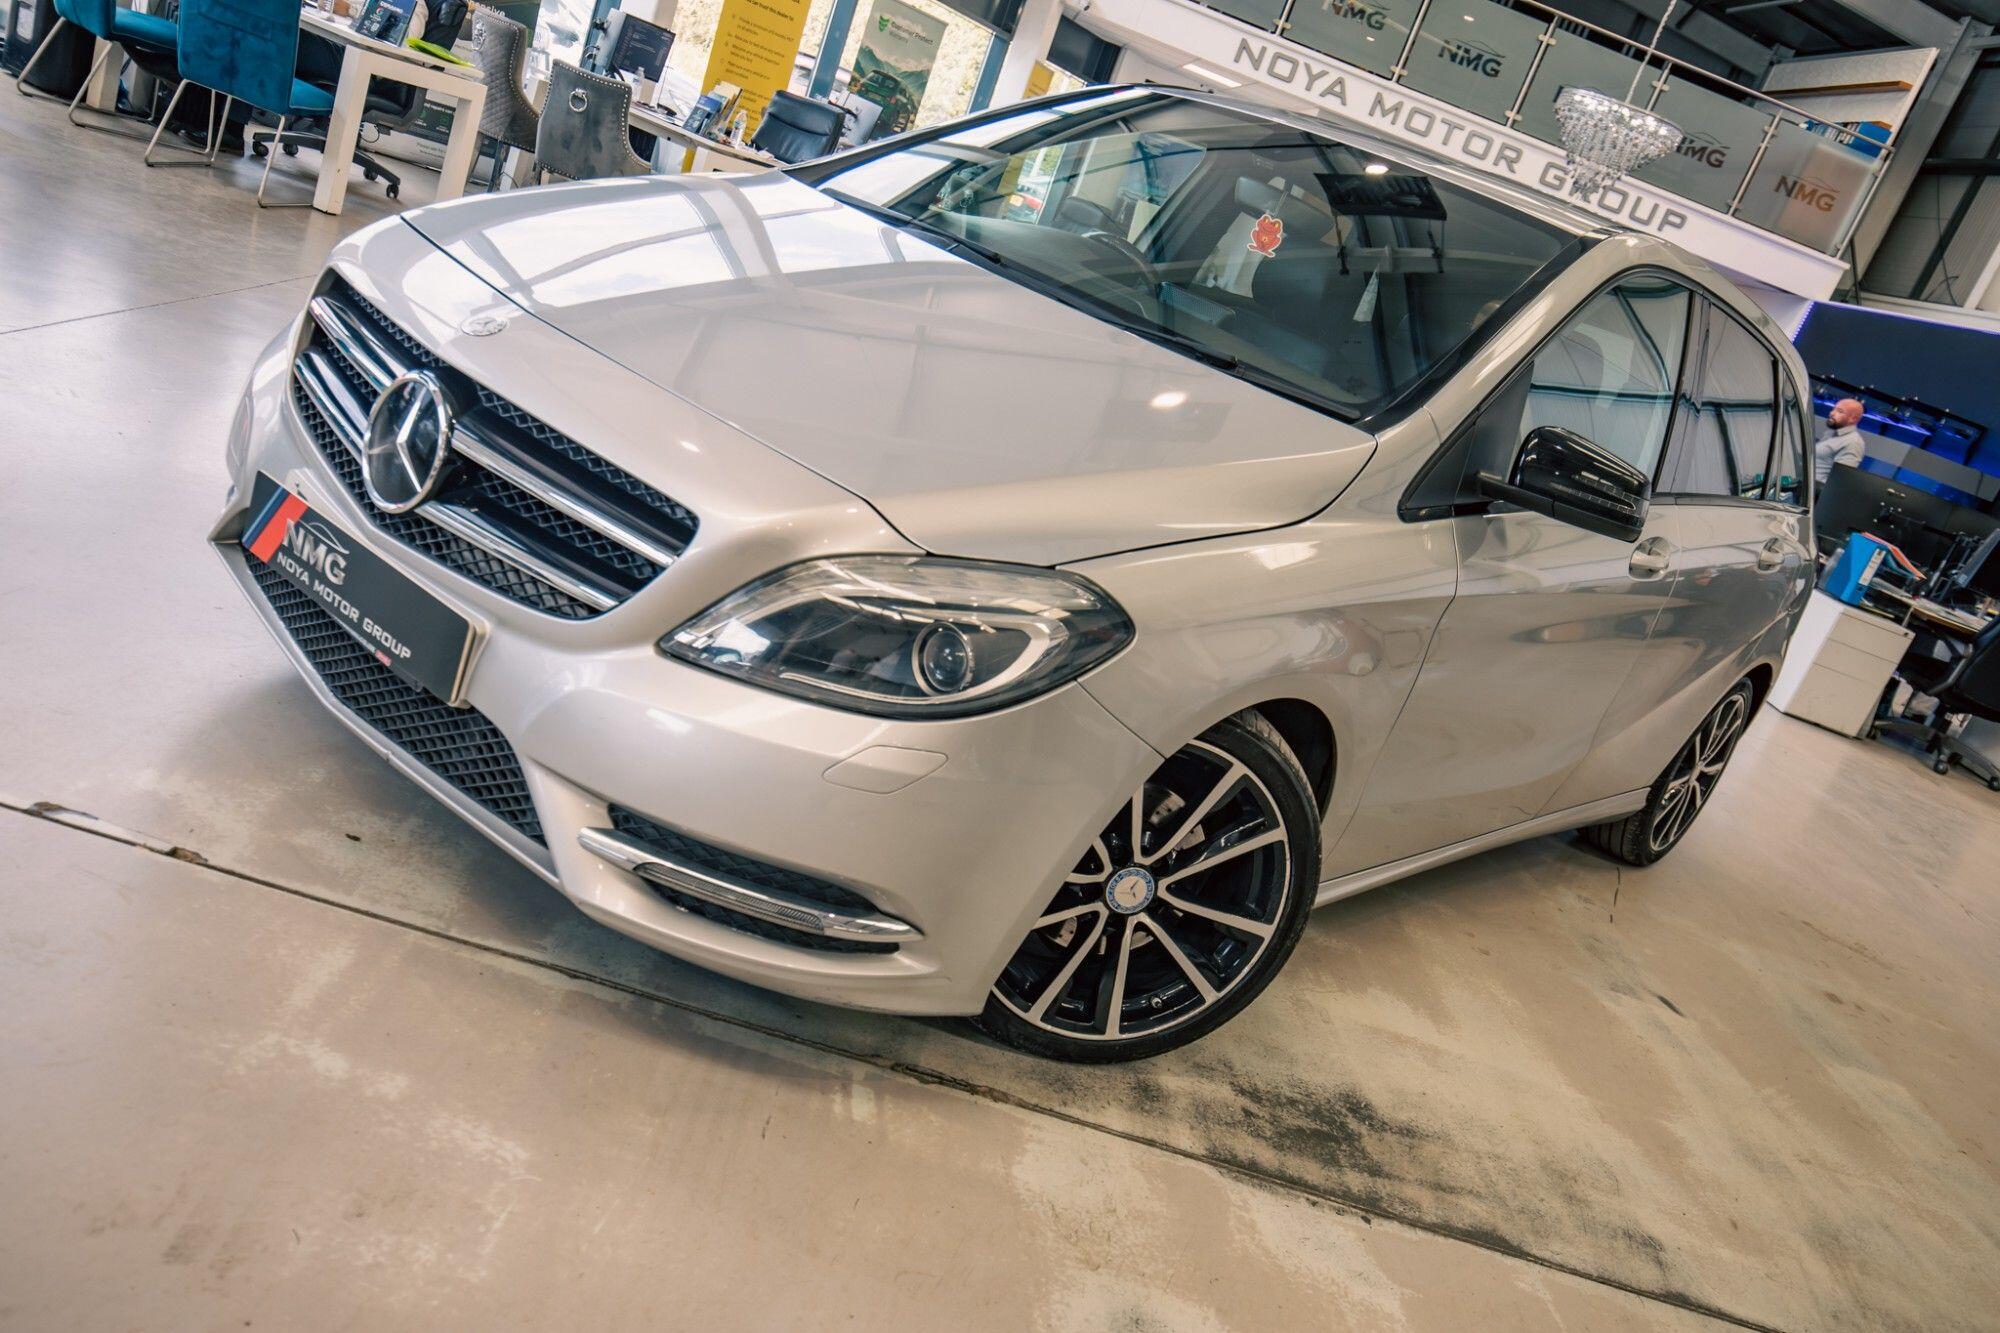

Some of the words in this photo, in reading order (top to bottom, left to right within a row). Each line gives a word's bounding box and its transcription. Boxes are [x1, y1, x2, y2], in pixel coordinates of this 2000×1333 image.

[1438, 40, 1502, 78] NMG
[1234, 38, 1347, 106] NOYA
[1369, 92, 1522, 174] MOTOR
[1773, 175, 1838, 212] NMG
[282, 518, 346, 586] NMG
[277, 552, 310, 585] NOYA
[313, 579, 360, 622] MOTOR
[362, 617, 411, 659] GROUP
